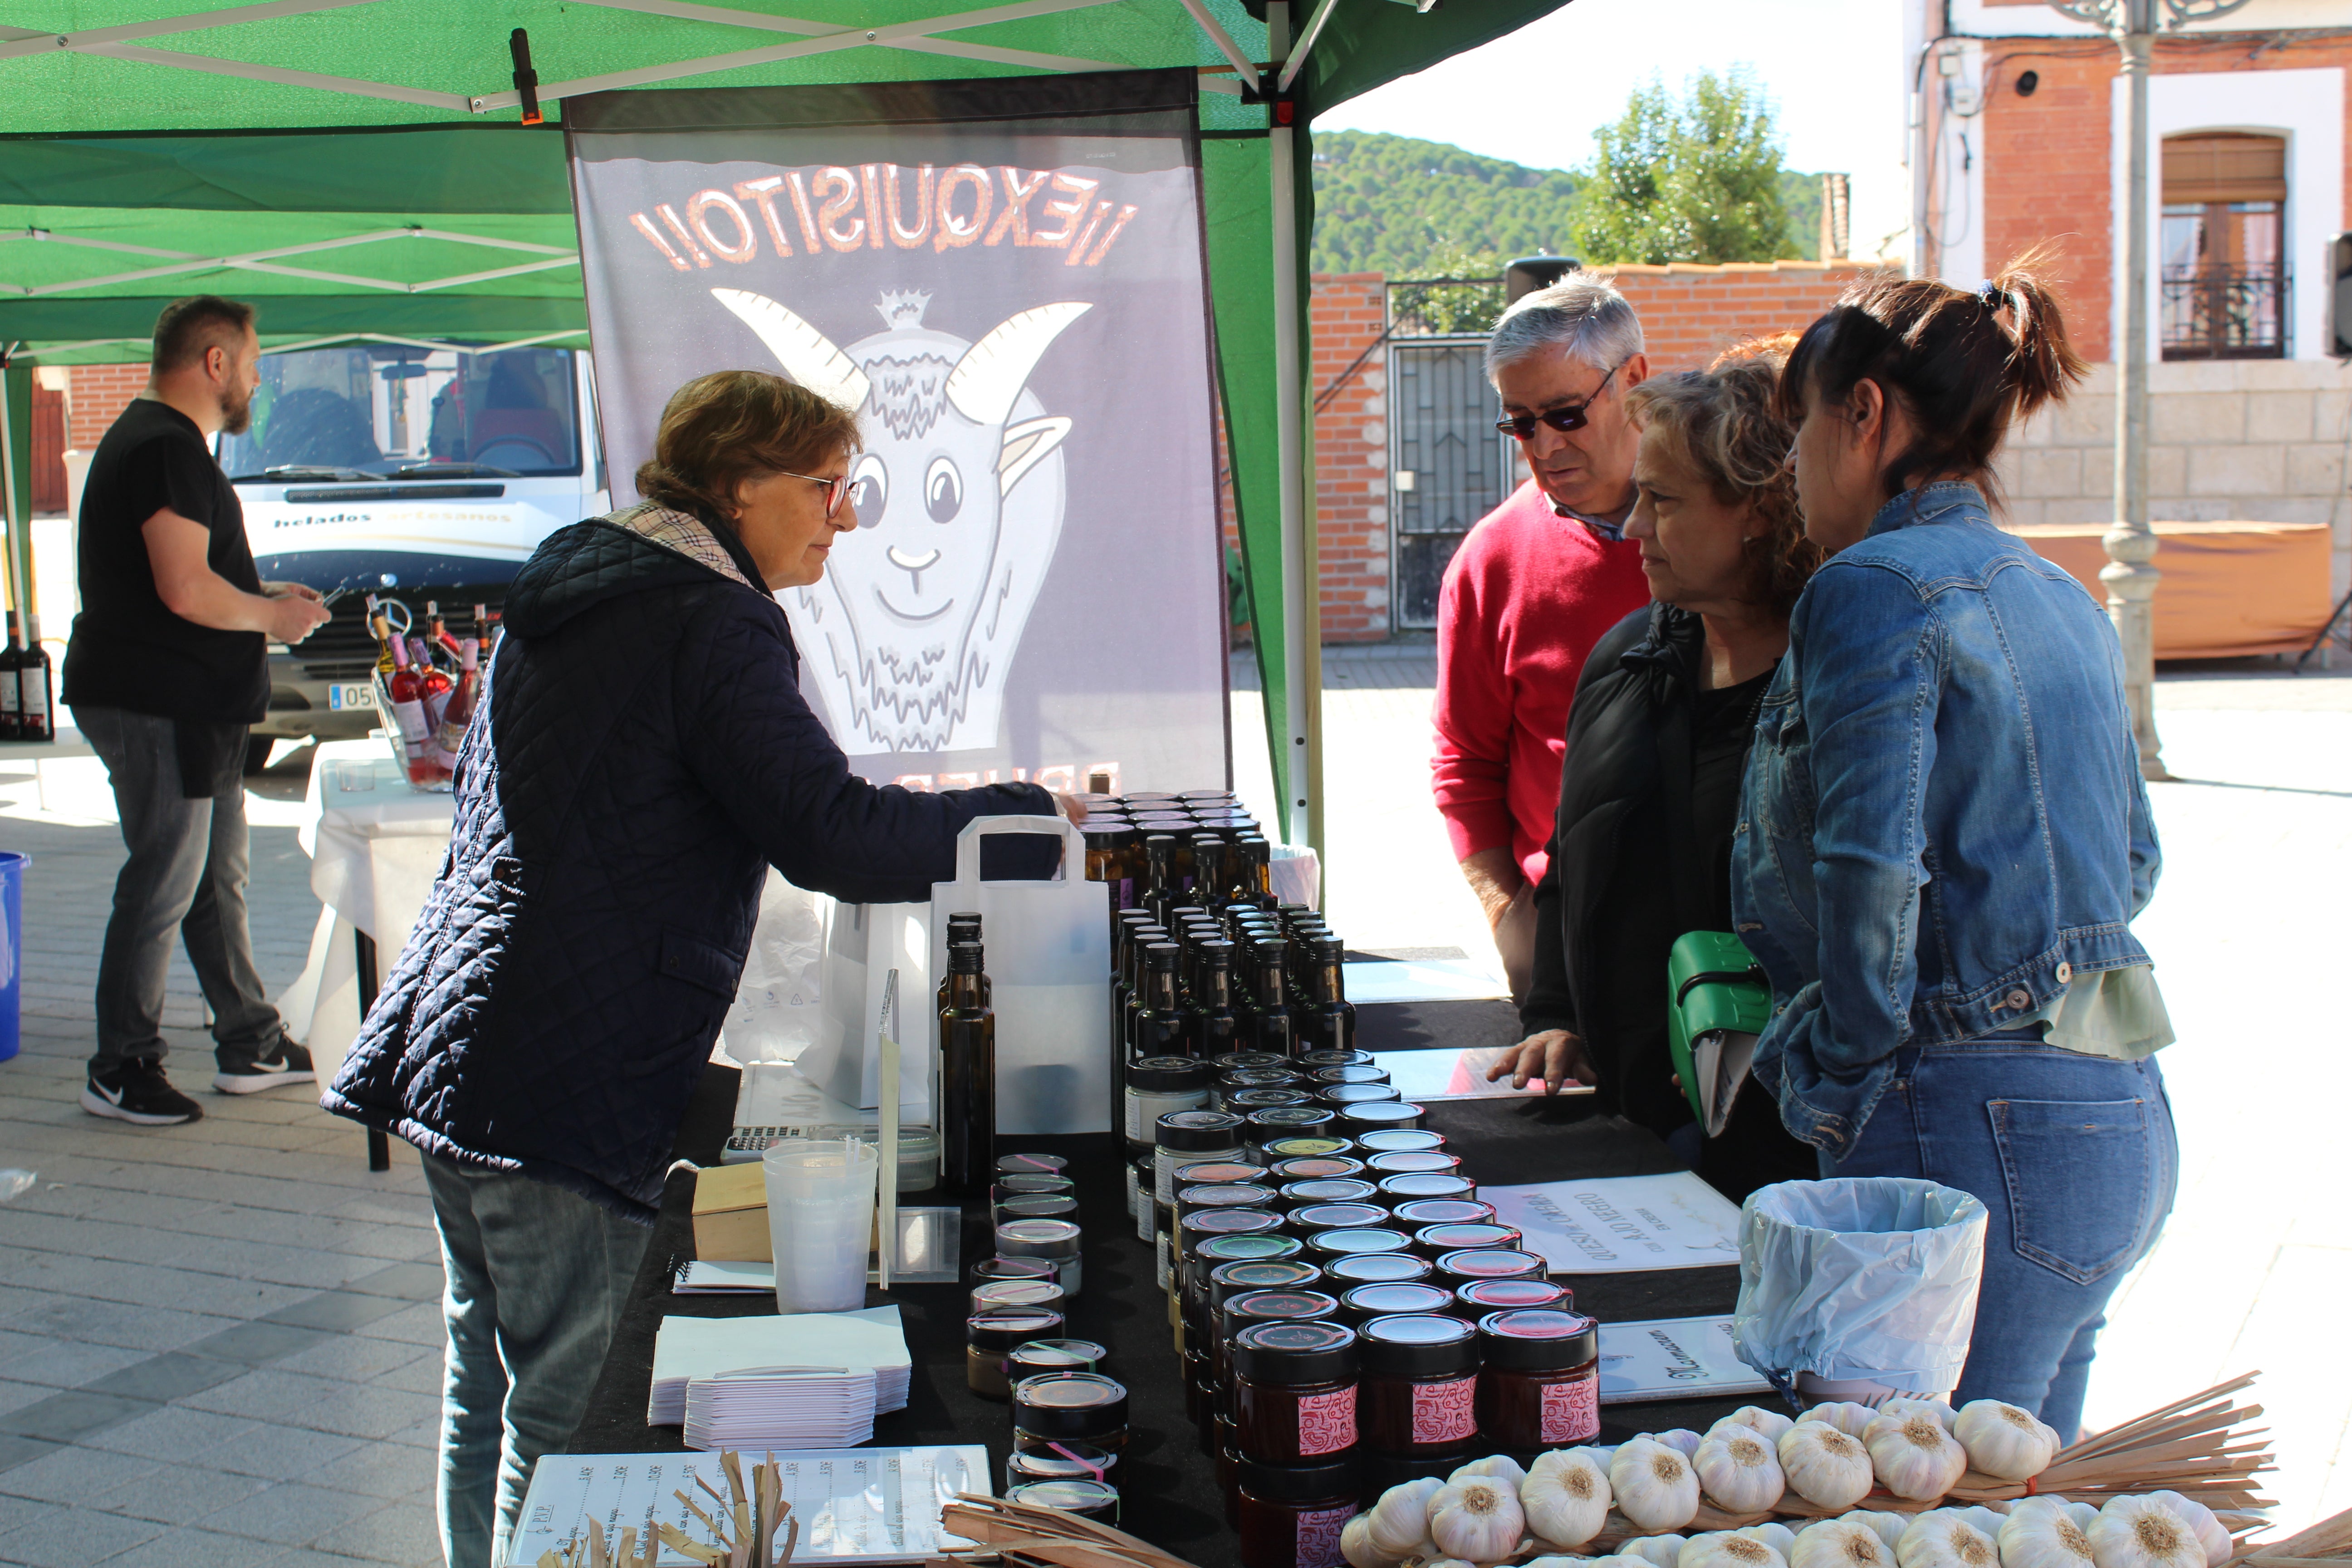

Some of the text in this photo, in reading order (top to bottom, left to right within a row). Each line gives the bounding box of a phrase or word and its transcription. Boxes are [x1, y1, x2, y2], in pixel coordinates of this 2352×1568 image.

[274, 510, 512, 528] helados artesanos
[780, 1093, 821, 1119] AJO
[1521, 1193, 1572, 1223] CABRA
[1573, 1192, 1666, 1253] CON AJO NEGRO
[1566, 1232, 1618, 1261] QUESO
